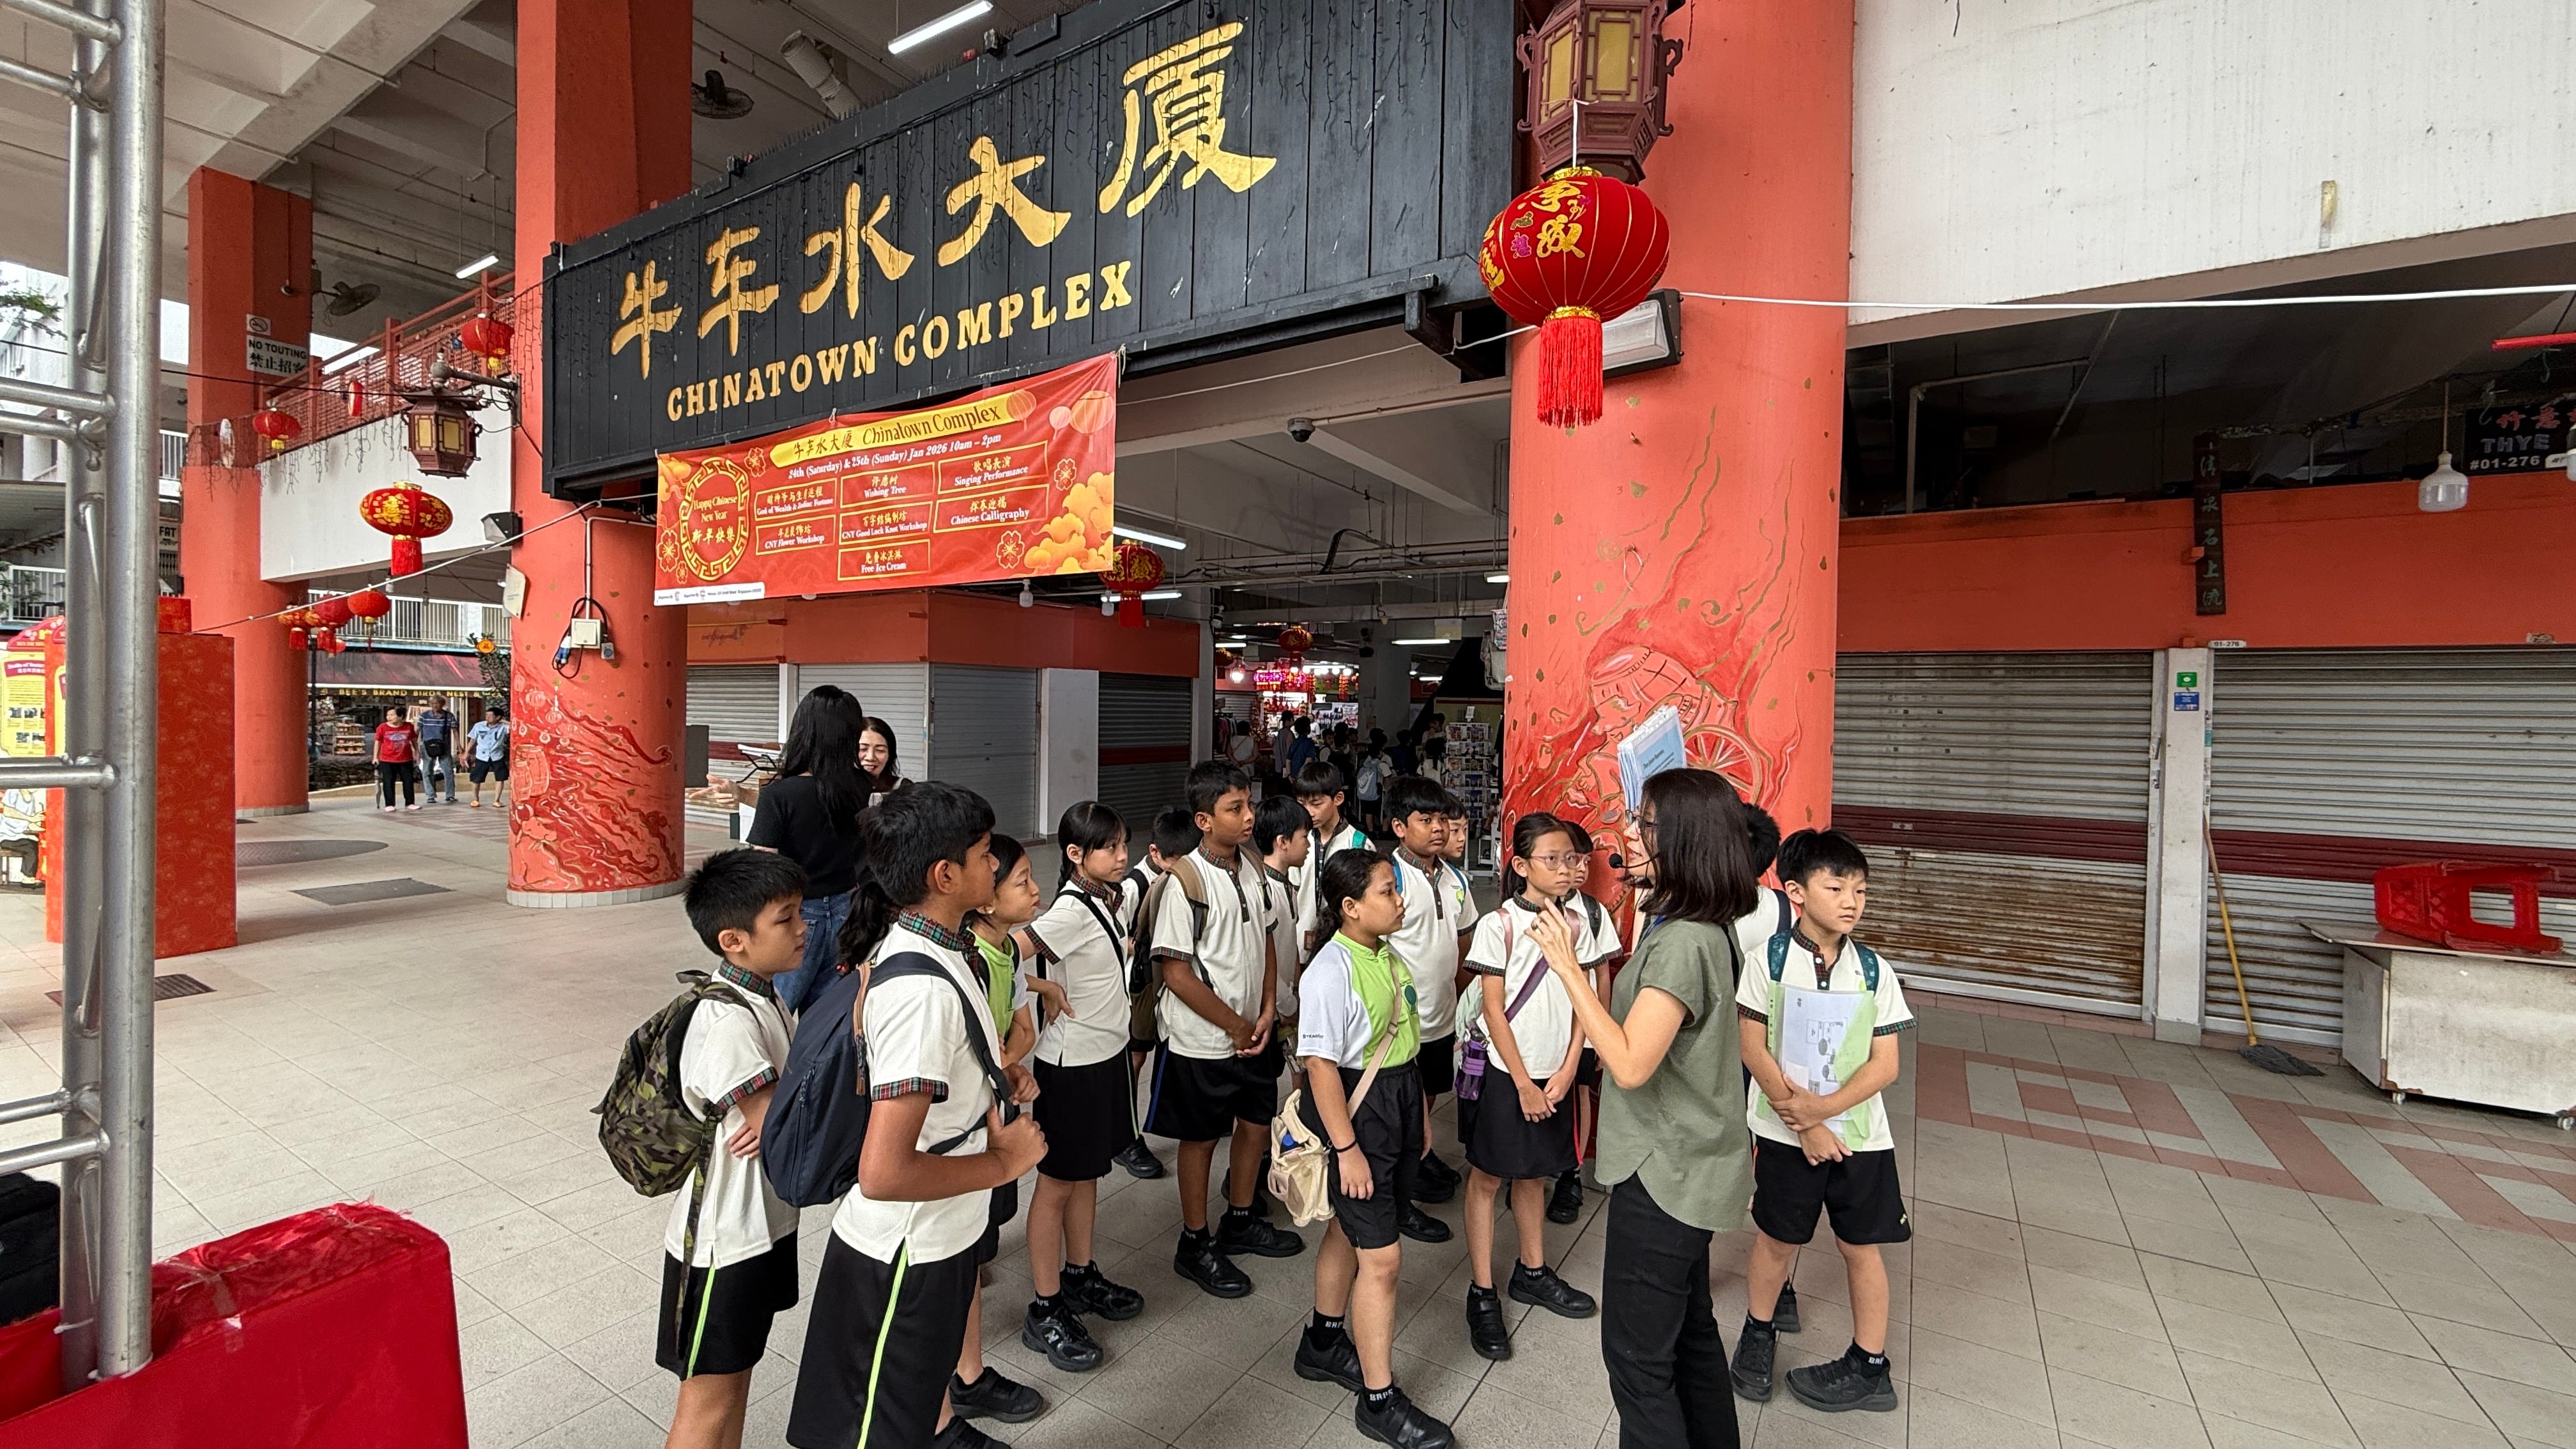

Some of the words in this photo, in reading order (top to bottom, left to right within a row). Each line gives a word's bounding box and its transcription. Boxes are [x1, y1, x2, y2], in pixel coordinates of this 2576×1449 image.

[249, 339, 263, 349] NO
[265, 343, 307, 359] TOUTING
[667, 335, 877, 422] CHINATOWN
[894, 261, 1132, 367] COMPLEX
[862, 420, 933, 445] Chinatown
[932, 404, 1002, 432] Complex
[793, 430, 854, 460] 牛车水大厦
[2480, 433, 2550, 454] THYE
[788, 469, 804, 479] 24th
[806, 460, 843, 478] (Saturday)
[843, 459, 851, 468] &
[852, 456, 870, 466] 25th
[871, 448, 908, 466] (Sunday)
[907, 448, 924, 462] Jan
[925, 443, 948, 456] 2026
[949, 438, 972, 452] 10am
[981, 434, 1002, 448] 2pm
[2469, 456, 2541, 471] #01-276
[954, 474, 983, 487] Singing
[983, 466, 1029, 482] Performance
[864, 487, 890, 498] Wishing
[890, 485, 907, 495] Tree
[693, 499, 712, 512] Happy
[712, 495, 738, 507] Chinese
[756, 506, 768, 516] God
[768, 505, 774, 514] of
[773, 503, 792, 514] Wealth
[813, 498, 834, 507] Fortune
[701, 512, 714, 523] New
[714, 510, 728, 521] Year
[950, 514, 979, 526] Chinese
[980, 507, 1031, 523] Calligraphy
[841, 530, 855, 540] CNY
[855, 528, 871, 538] Good
[871, 526, 884, 536] Luck
[885, 525, 898, 534] Knot
[898, 521, 928, 532] Workshop
[765, 540, 778, 549] CNY
[778, 538, 796, 548] Flower
[795, 533, 825, 545] Workshop
[861, 564, 875, 574] Free
[875, 563, 886, 572] Ice
[886, 562, 907, 571] Cream
